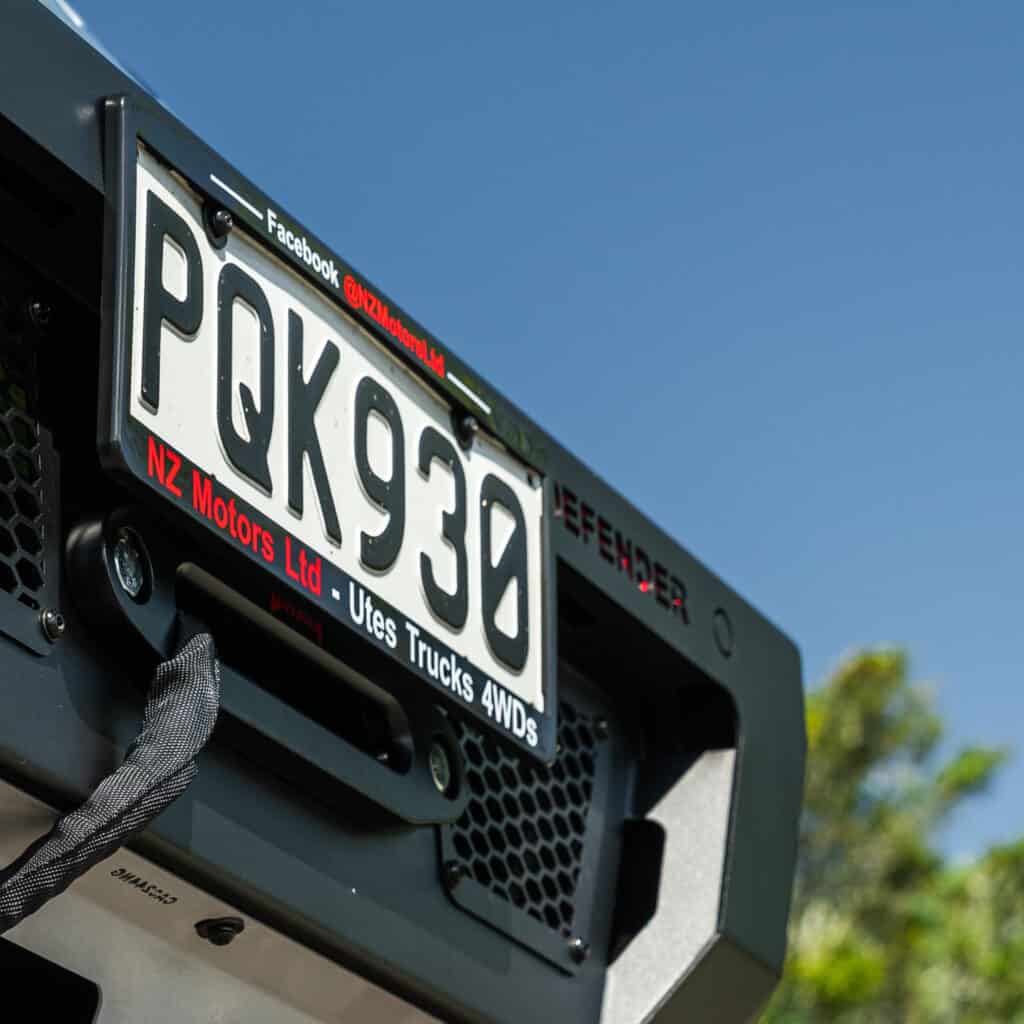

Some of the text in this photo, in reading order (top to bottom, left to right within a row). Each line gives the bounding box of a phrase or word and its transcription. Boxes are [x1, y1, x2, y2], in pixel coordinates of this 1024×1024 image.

[267, 208, 340, 288] Facebook
[138, 188, 529, 677] PQK930
[147, 434, 184, 497] NZ
[192, 468, 275, 563] Motors
[284, 535, 322, 597] Ltd
[349, 581, 398, 649] Utes
[405, 621, 475, 703] Trucks
[481, 679, 539, 748] 4WDs
